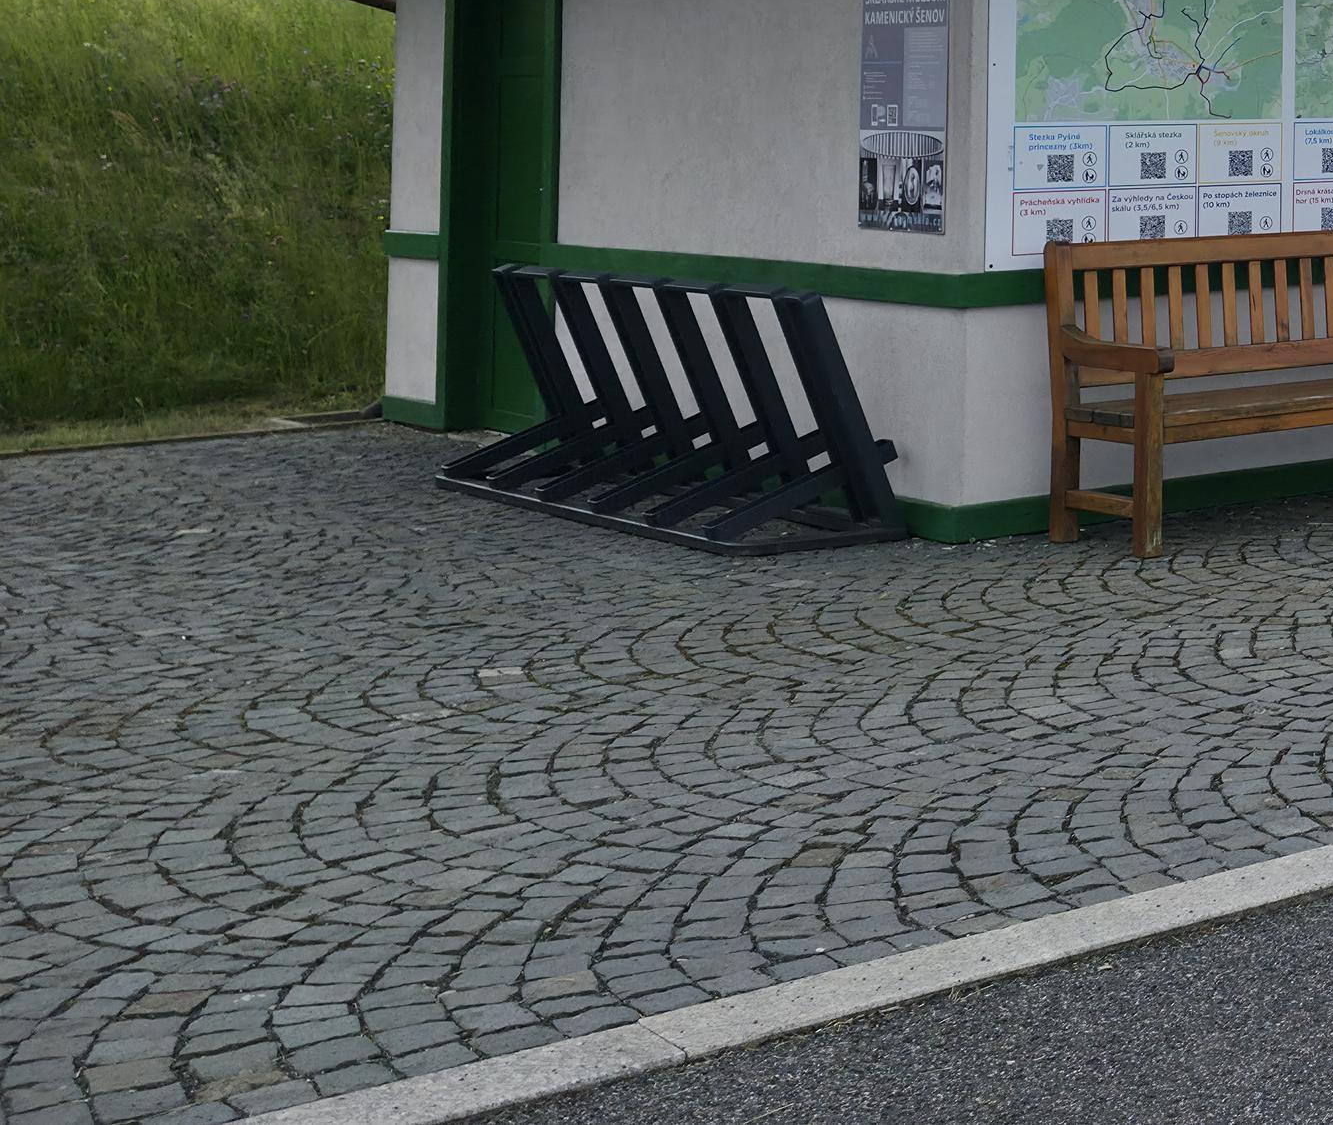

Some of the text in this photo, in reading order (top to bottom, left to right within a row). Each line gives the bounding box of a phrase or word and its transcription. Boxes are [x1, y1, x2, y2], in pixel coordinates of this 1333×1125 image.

[865, 7, 945, 25] KAMENICKÝ ŠENOV
[1028, 133, 1055, 141] Stezka
[1125, 131, 1157, 139] Sklářská
[1125, 141, 1150, 149] (2 km)
[1319, 137, 1333, 145] km)
[1202, 190, 1277, 200] Po stopách železnice
[1295, 188, 1316, 196] Drsná
[1067, 197, 1100, 206] vyhlídka
[1111, 195, 1122, 203] Za
[1124, 194, 1153, 204] výhledy
[1166, 192, 1193, 201] Českou
[1309, 197, 1318, 205] (15
[1319, 196, 1333, 204] km)
[1111, 203, 1179, 212] skálu (3,5/6,5 km)
[1202, 201, 1214, 209] (10
[1019, 208, 1046, 217] (3 km)
